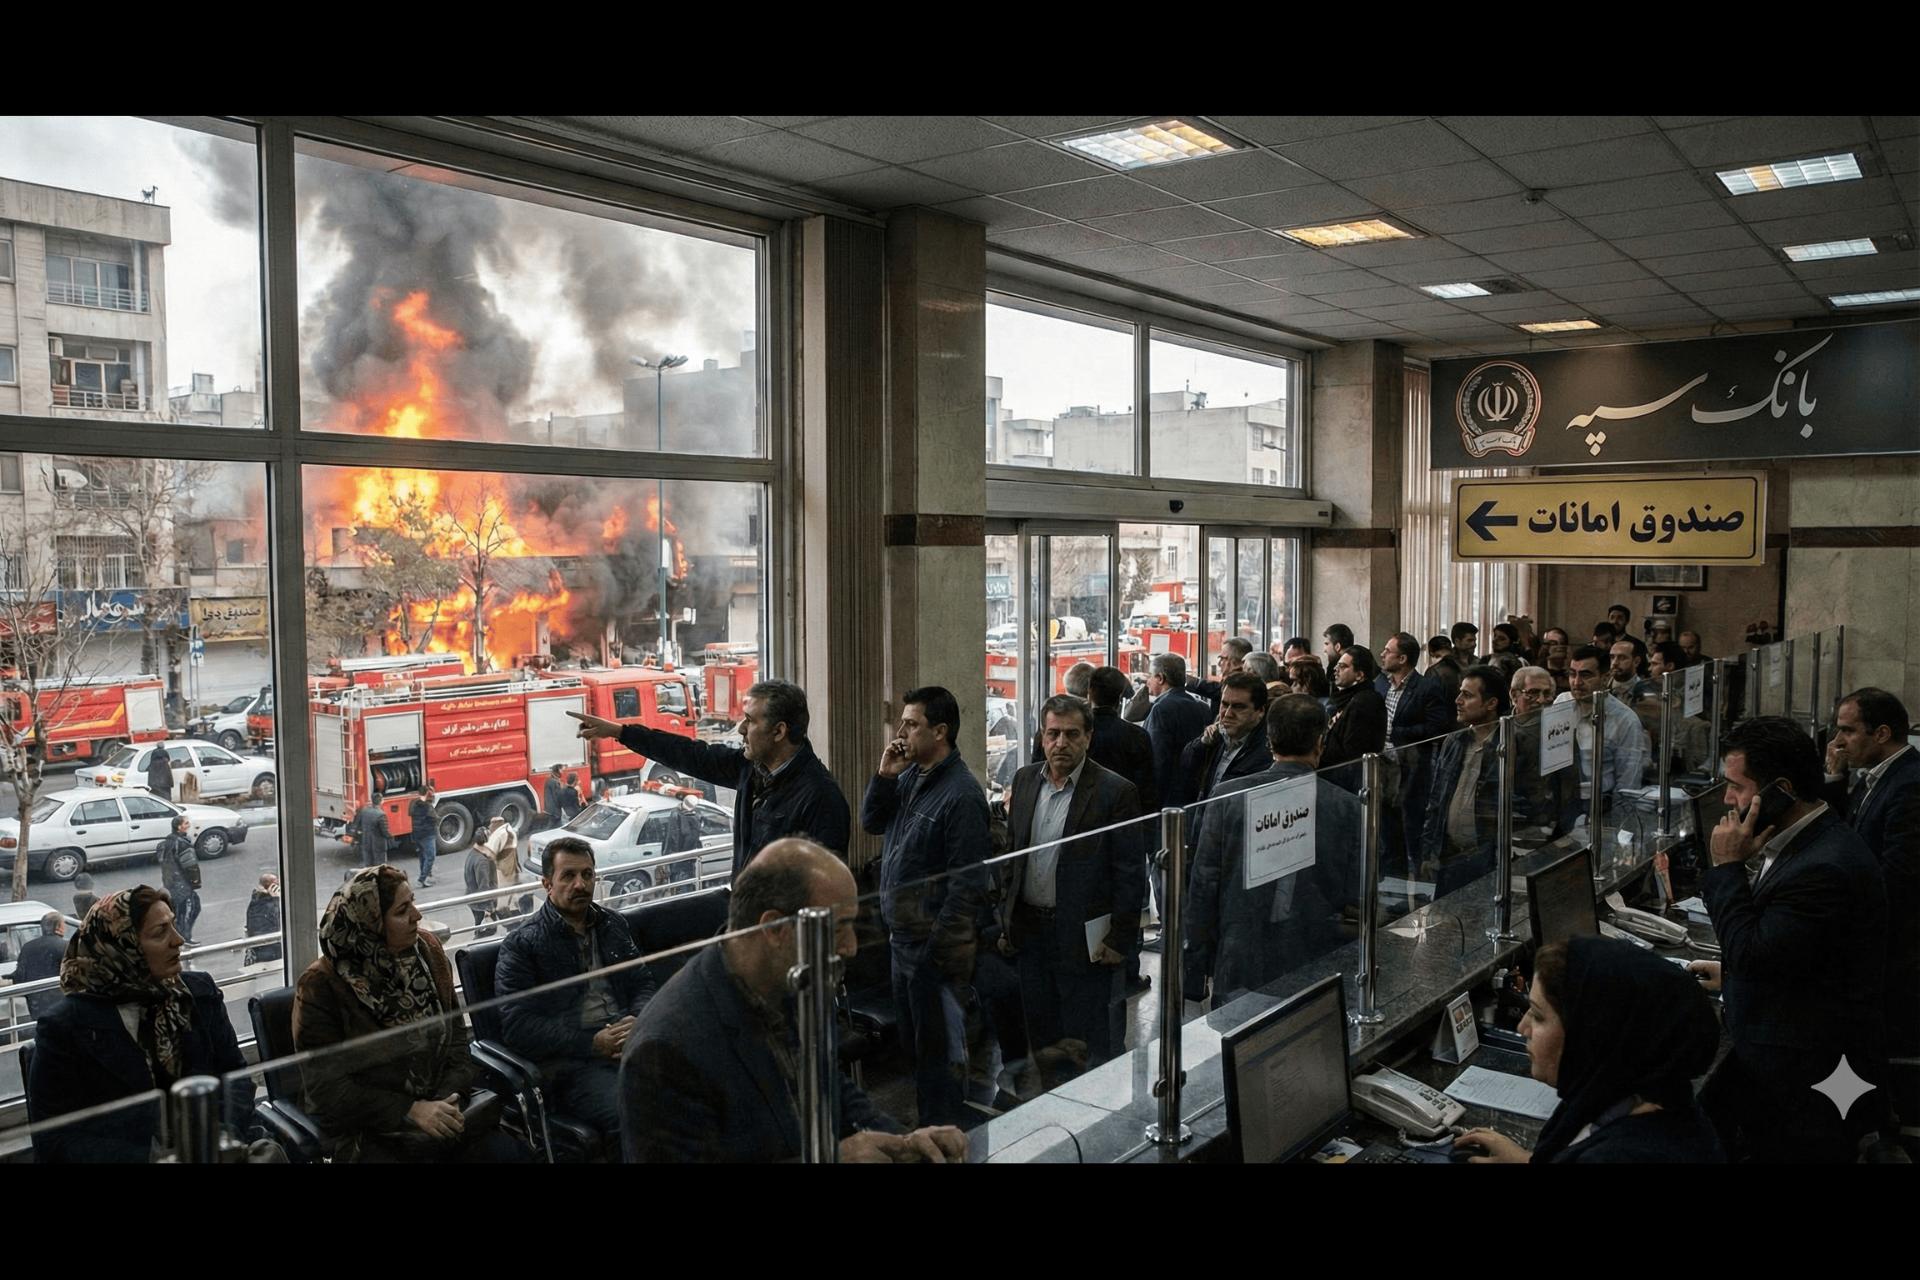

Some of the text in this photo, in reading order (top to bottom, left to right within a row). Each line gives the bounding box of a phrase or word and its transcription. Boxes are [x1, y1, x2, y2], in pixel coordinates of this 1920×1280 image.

[1566, 372, 1709, 457] سپه
[1528, 500, 1745, 544] صندوق امانات
